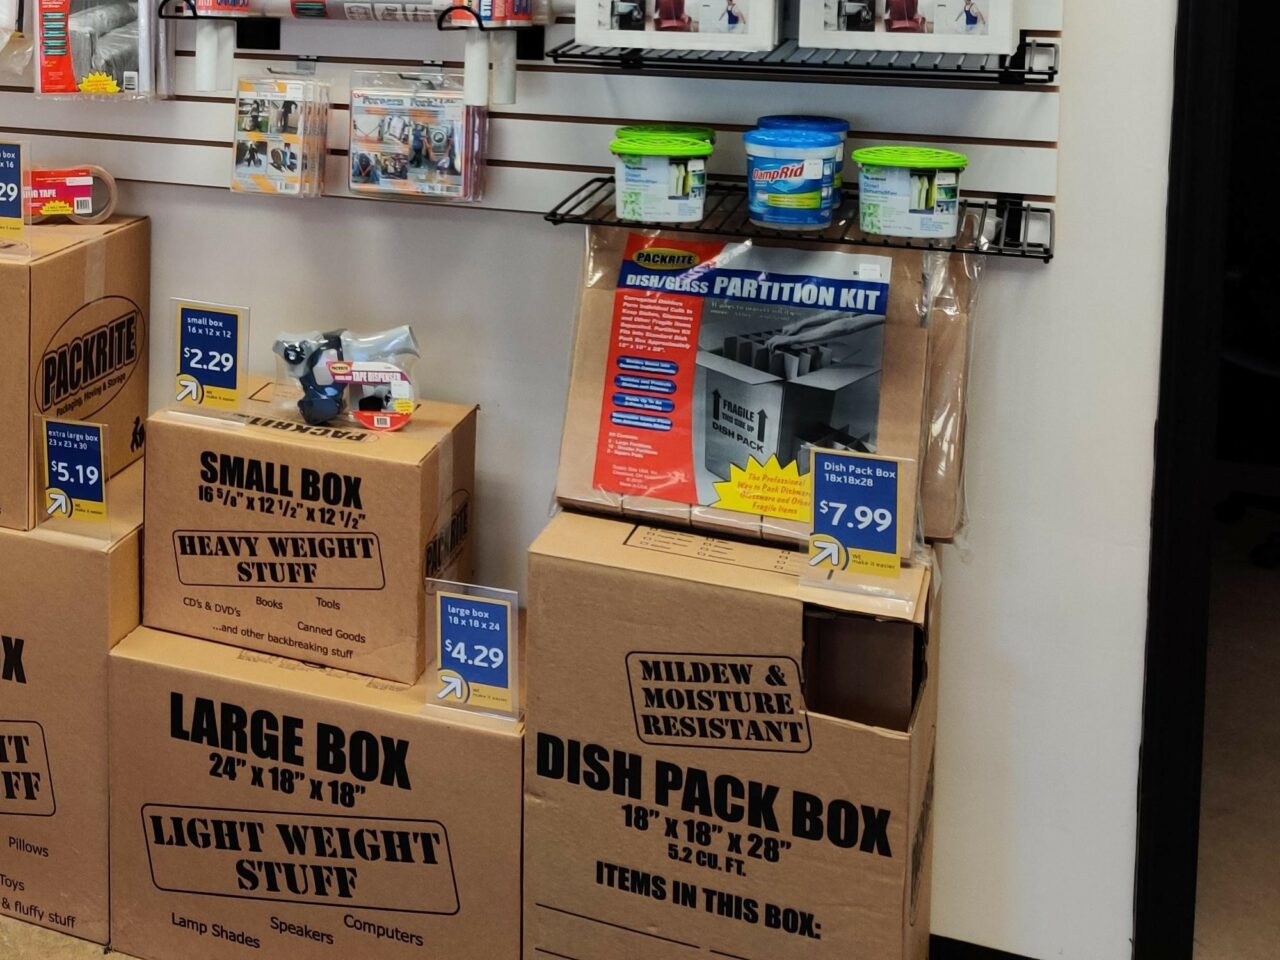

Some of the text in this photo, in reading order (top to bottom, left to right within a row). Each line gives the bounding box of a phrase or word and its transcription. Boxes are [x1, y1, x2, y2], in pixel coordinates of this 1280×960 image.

[2, 150, 15, 159] box
[752, 163, 805, 183] DampRid
[636, 251, 696, 265] PACKRITE
[625, 273, 881, 311] DISH/GLASS PARTITION KIT
[187, 316, 224, 328] small box
[42, 310, 137, 411] PACKRITE
[184, 347, 234, 373] $2.29
[723, 399, 754, 423] FRAGILE
[48, 429, 99, 442] extra large box
[712, 421, 764, 454] DISH PACK
[51, 461, 99, 486] $5.19
[200, 450, 363, 510] SMALL BOX
[824, 461, 896, 478] Dish Pack Box
[824, 473, 874, 487] 18x18x28
[819, 499, 893, 533] $7.99
[178, 535, 375, 560] HEAVY WEIGHT
[237, 562, 318, 584] STUFF
[183, 596, 242, 617] CD's & DVD's
[255, 596, 341, 611] Books Tools
[447, 605, 490, 619] large box
[297, 621, 366, 645] Canned Goods
[445, 639, 504, 669] $4.29
[170, 692, 412, 791] LARGE BOX
[536, 731, 893, 858] DISH PACK BOX
[8, 836, 49, 858] Pillows
[149, 815, 441, 865] LIGHT WEIGHT
[235, 858, 358, 899] STUFF
[596, 860, 822, 940] ITEMS IN THIS BOX:
[171, 912, 424, 949] Lamp Shades Speakers Computers
